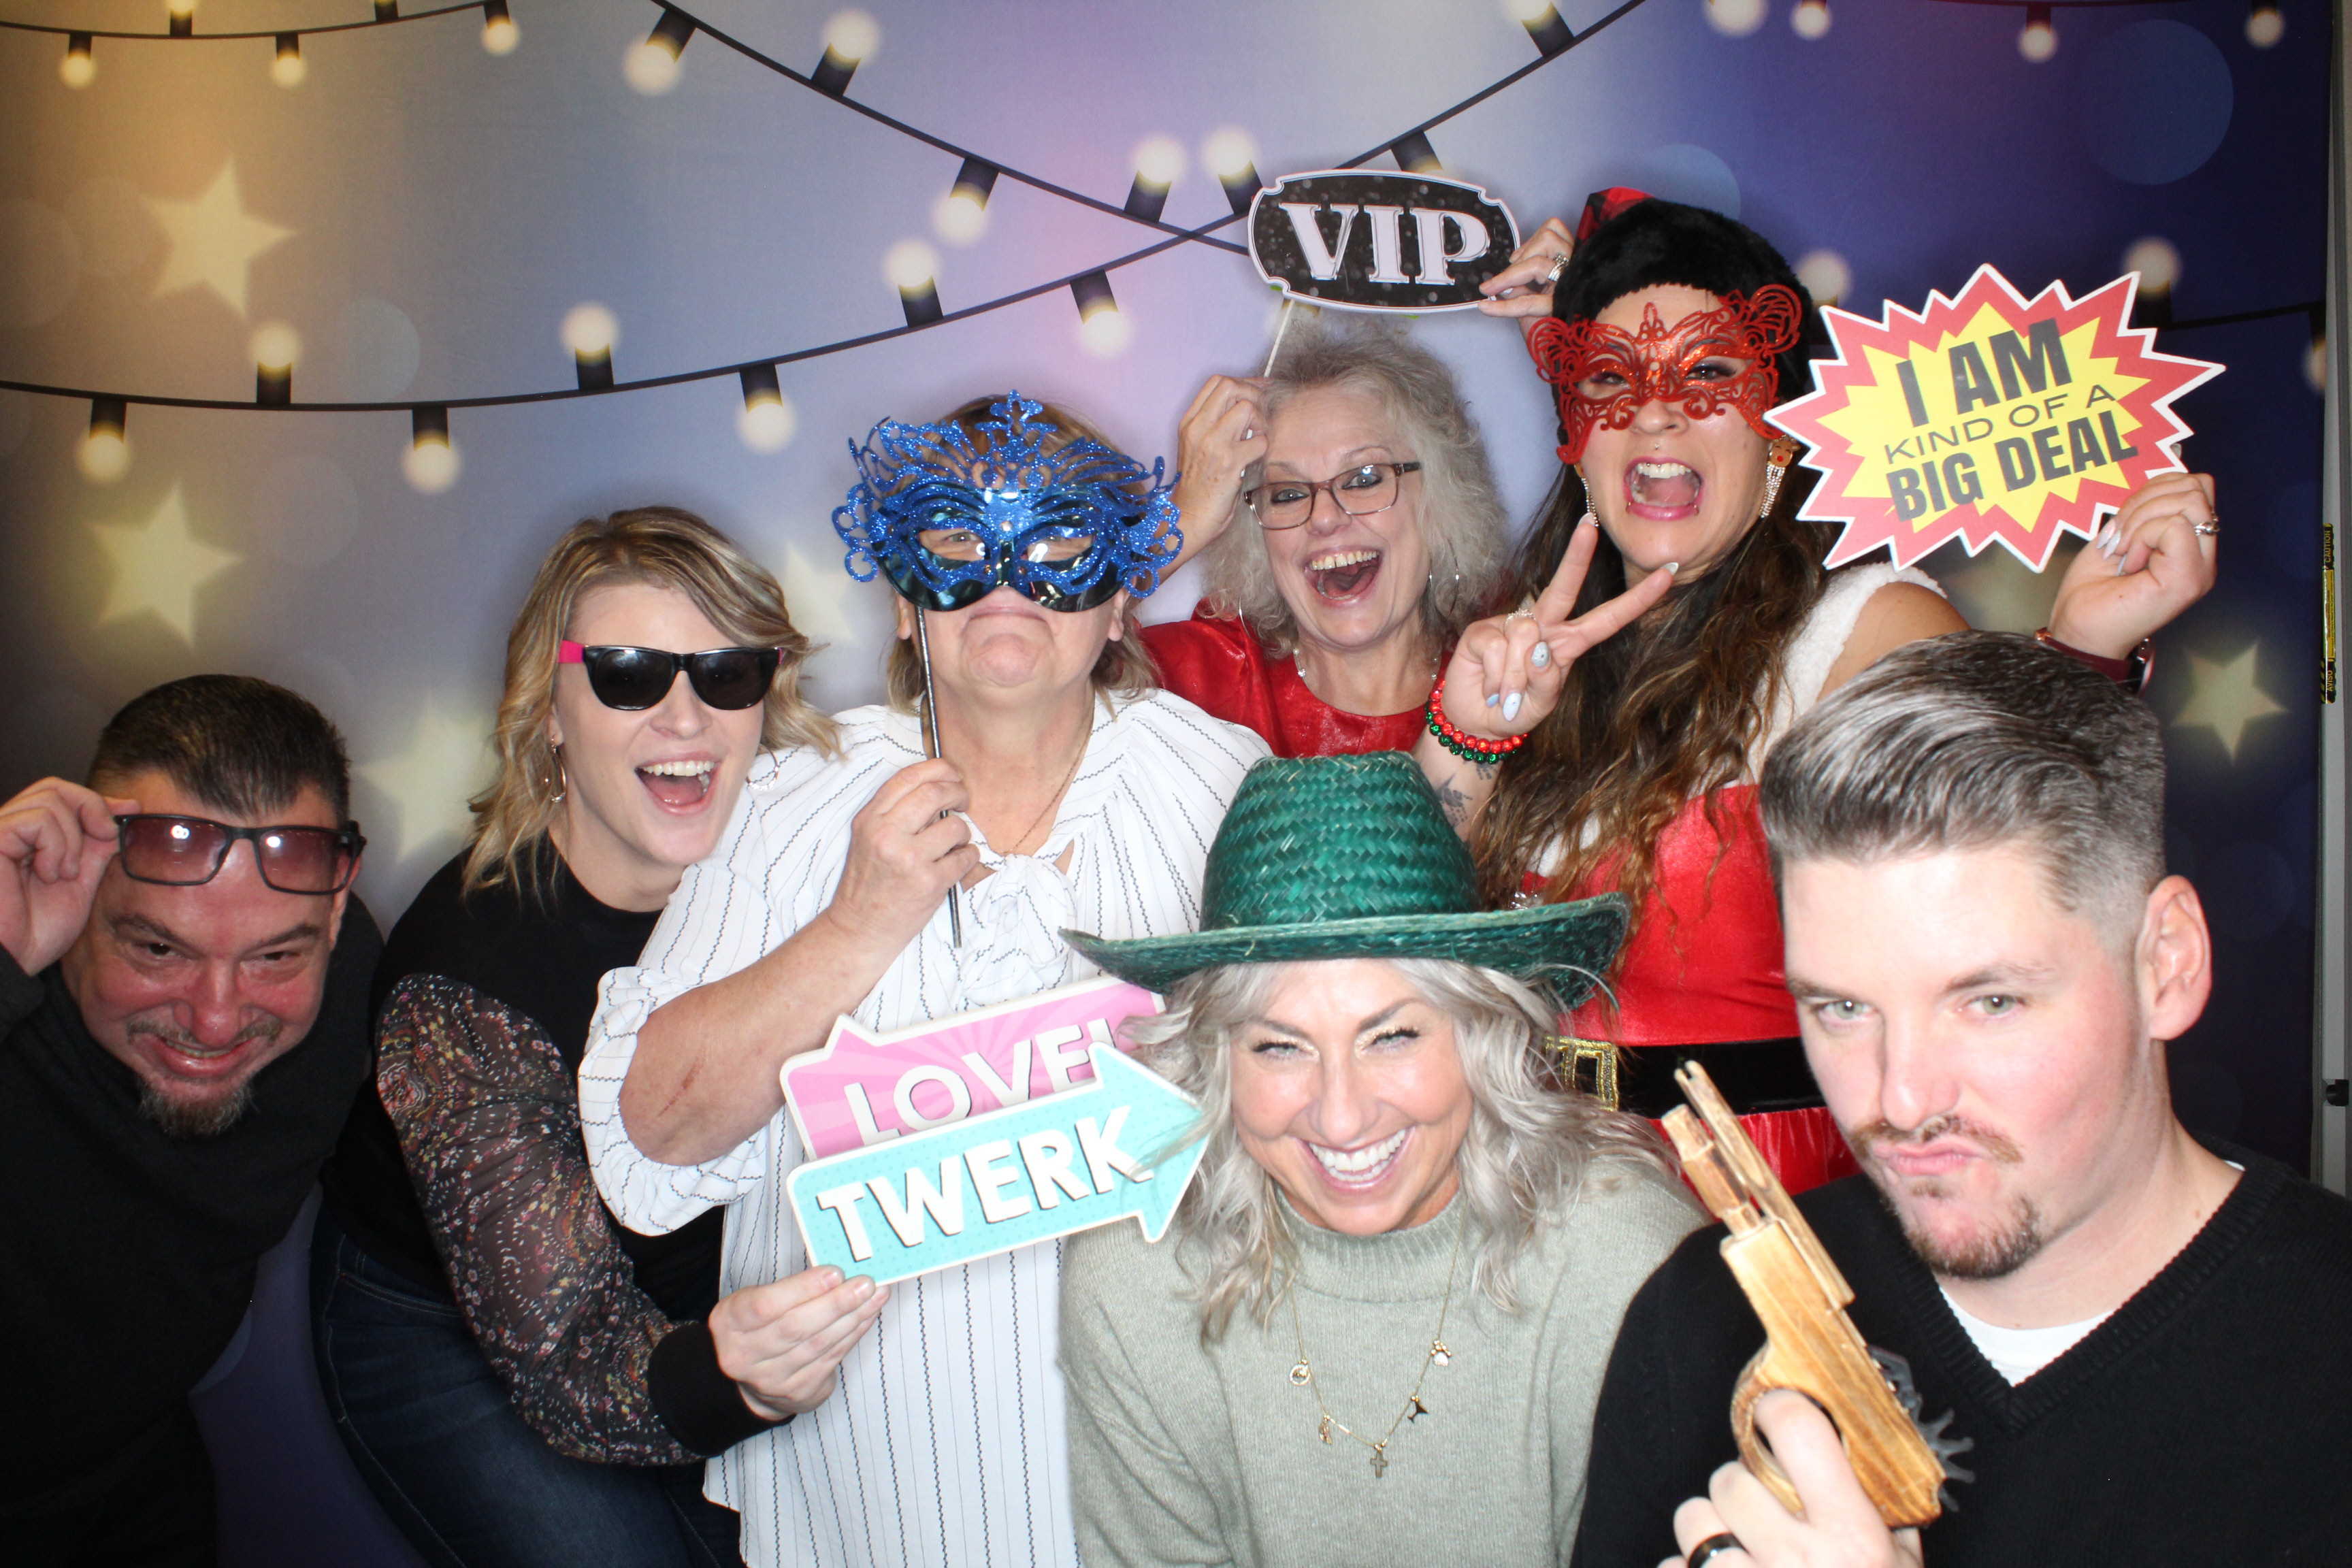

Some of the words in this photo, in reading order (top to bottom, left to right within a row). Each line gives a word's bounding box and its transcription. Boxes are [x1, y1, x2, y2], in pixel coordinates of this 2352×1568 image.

[1279, 203, 1491, 286] VIP
[1884, 417, 1994, 465] KIND
[2008, 393, 2070, 427] OF
[2086, 384, 2117, 408] A
[1895, 359, 1930, 428] I
[1948, 317, 2072, 414] AM
[1886, 451, 1983, 523] BIG
[1994, 409, 2138, 492] DEAL
[816, 1105, 1155, 1263] TWERK
